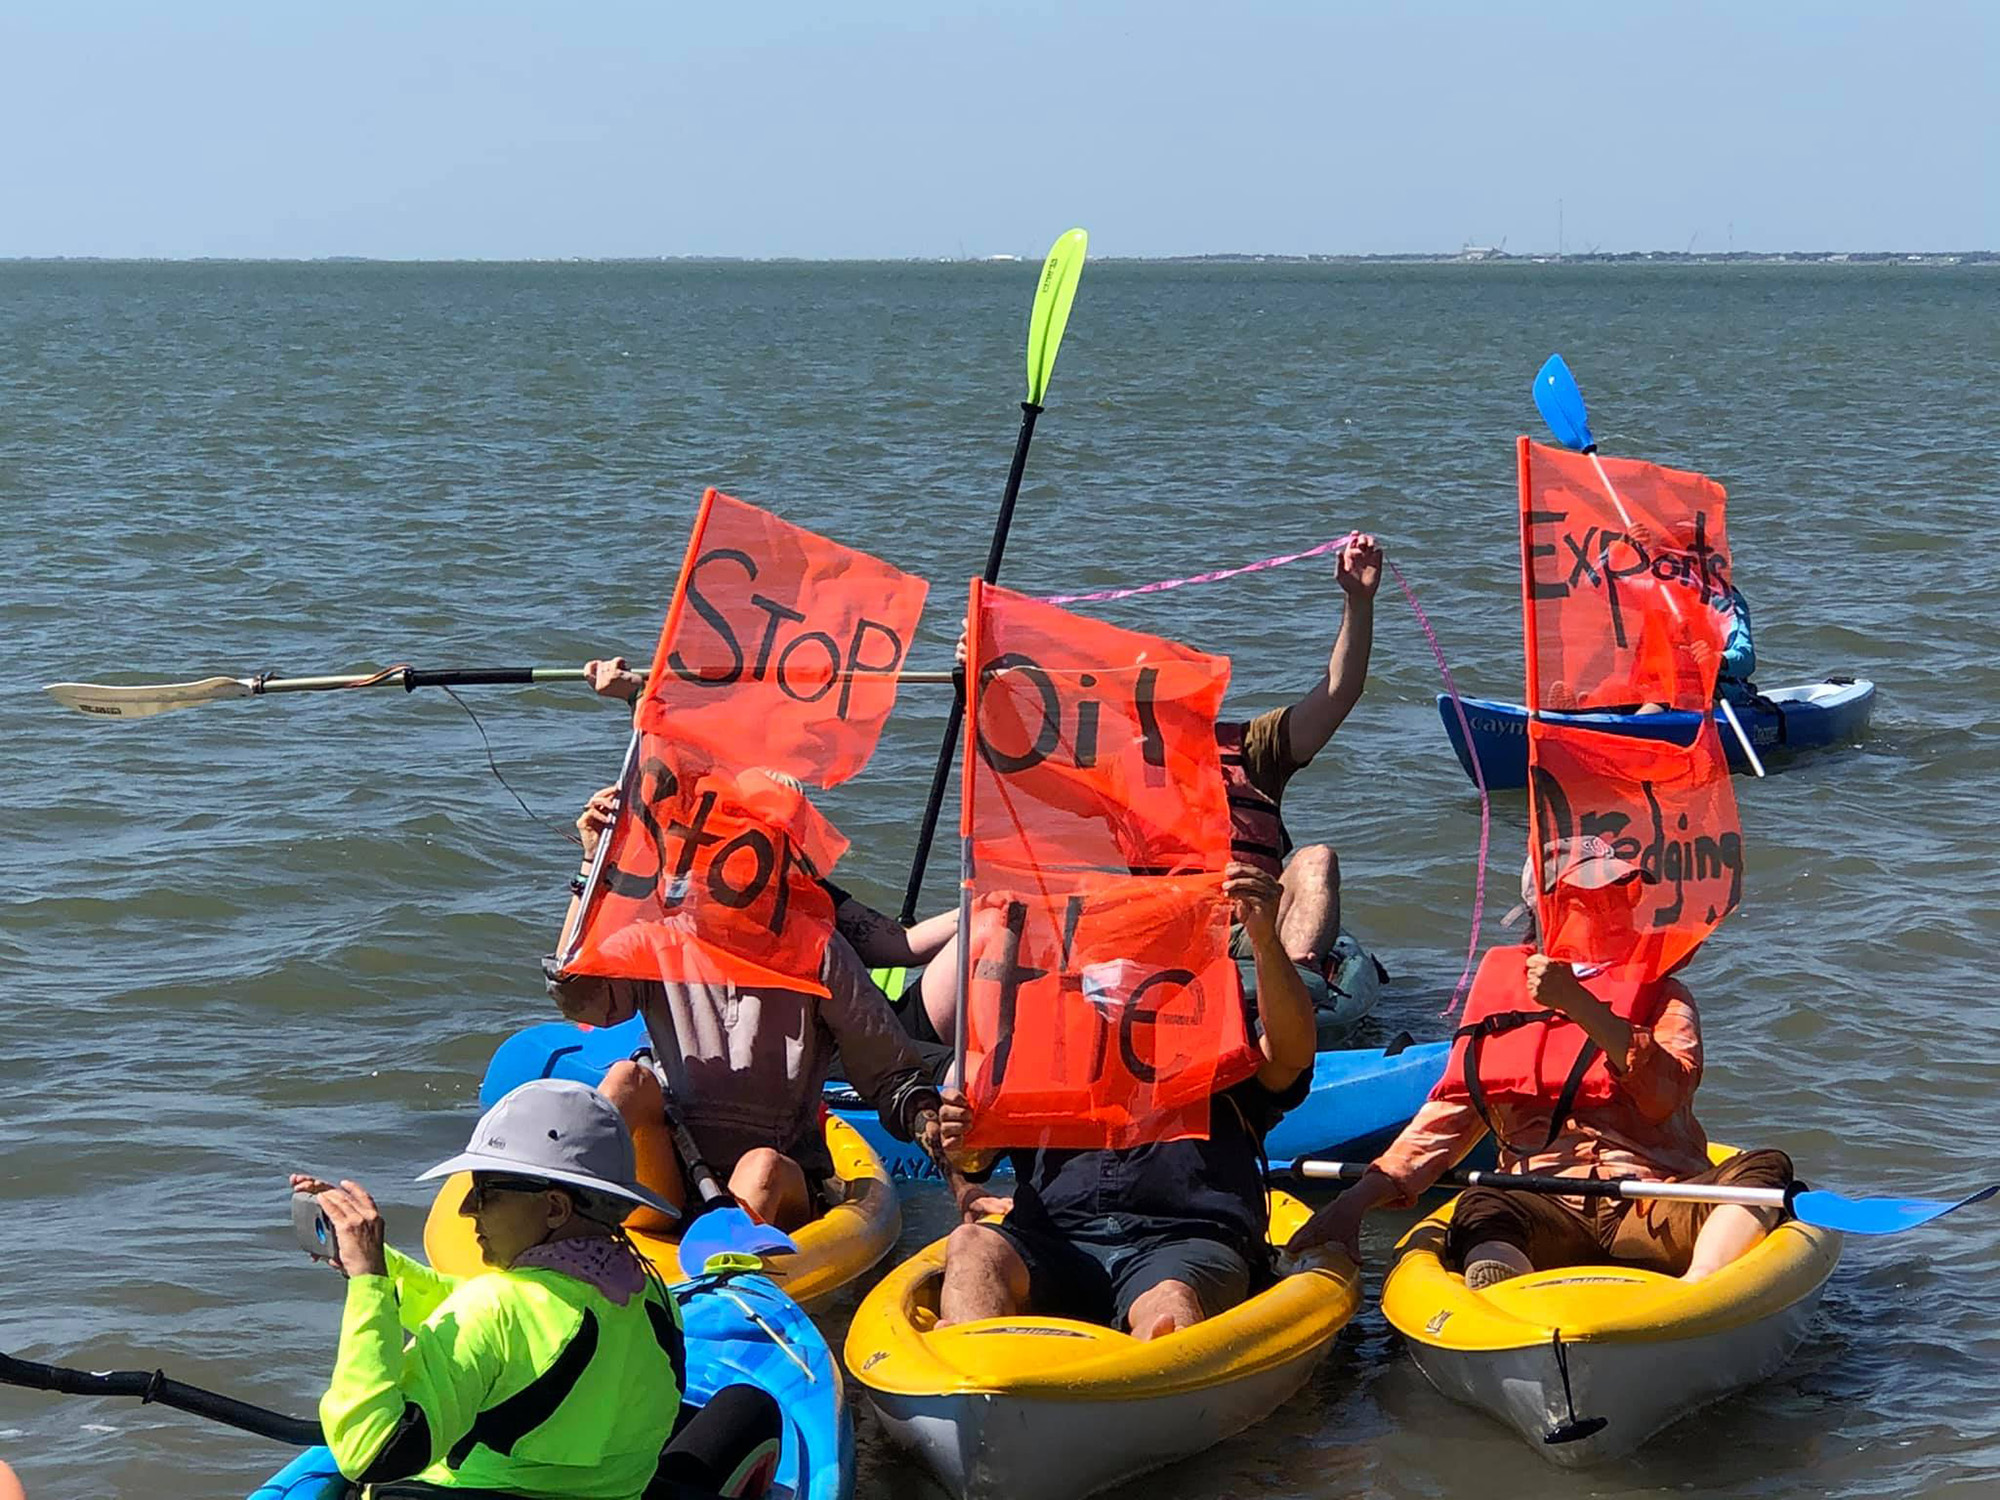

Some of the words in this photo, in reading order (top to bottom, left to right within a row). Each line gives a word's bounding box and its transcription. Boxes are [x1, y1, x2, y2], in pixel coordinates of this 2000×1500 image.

[1524, 511, 1732, 648] Exports
[977, 653, 1166, 775] Oil
[1530, 765, 1743, 927] Dredging
[972, 895, 1205, 1086] the
